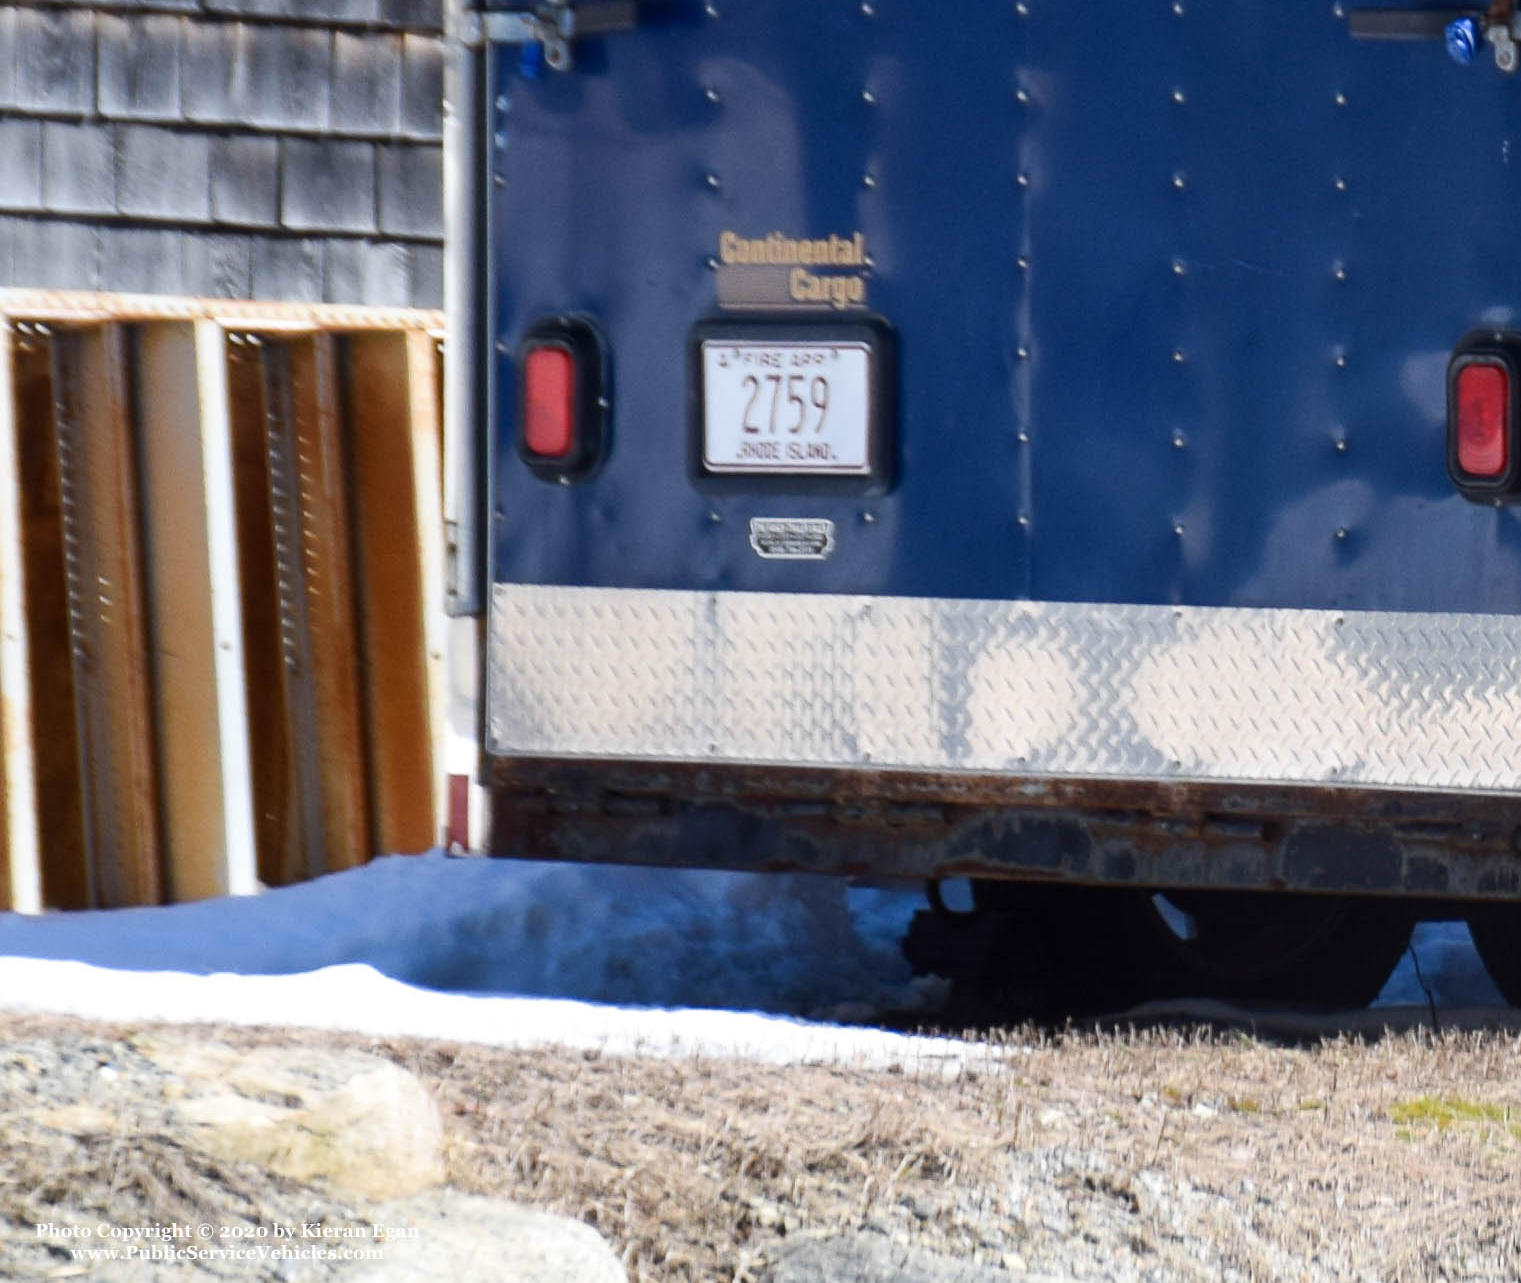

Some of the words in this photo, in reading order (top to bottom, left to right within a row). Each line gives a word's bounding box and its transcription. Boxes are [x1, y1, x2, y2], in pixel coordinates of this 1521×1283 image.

[719, 230, 864, 265] Continental
[790, 267, 864, 309] Cargo
[742, 374, 830, 435] 2759
